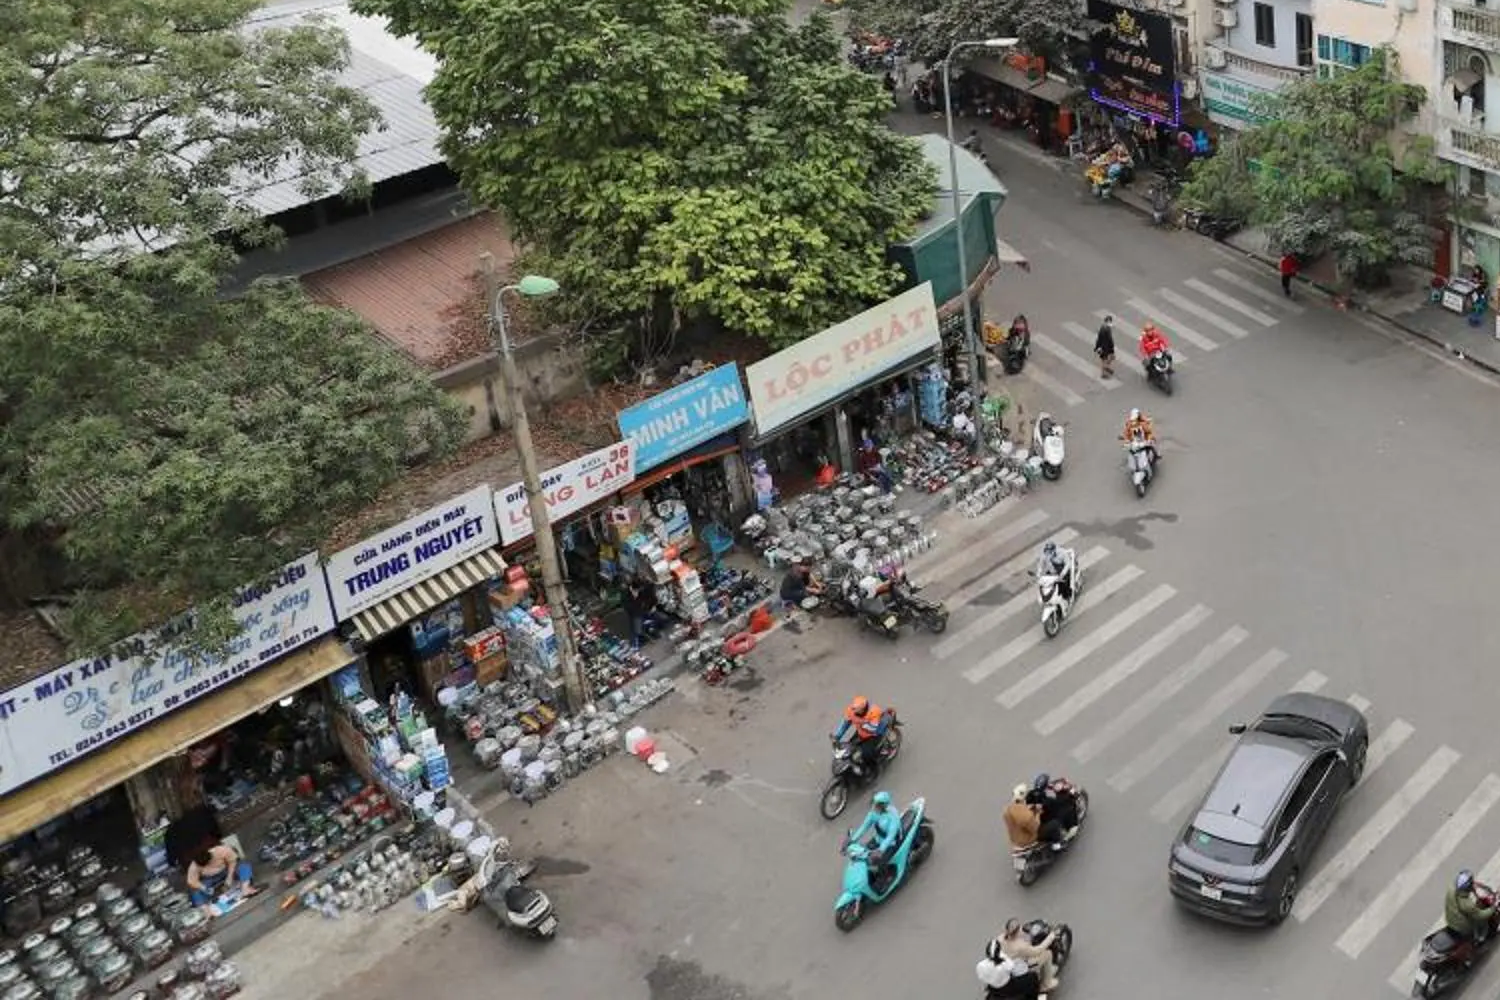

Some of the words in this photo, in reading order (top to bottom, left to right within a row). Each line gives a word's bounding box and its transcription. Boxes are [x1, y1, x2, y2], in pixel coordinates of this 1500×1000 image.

[628, 407, 690, 448] MINH
[585, 458, 630, 490] LAN
[344, 553, 411, 597] TRUNG
